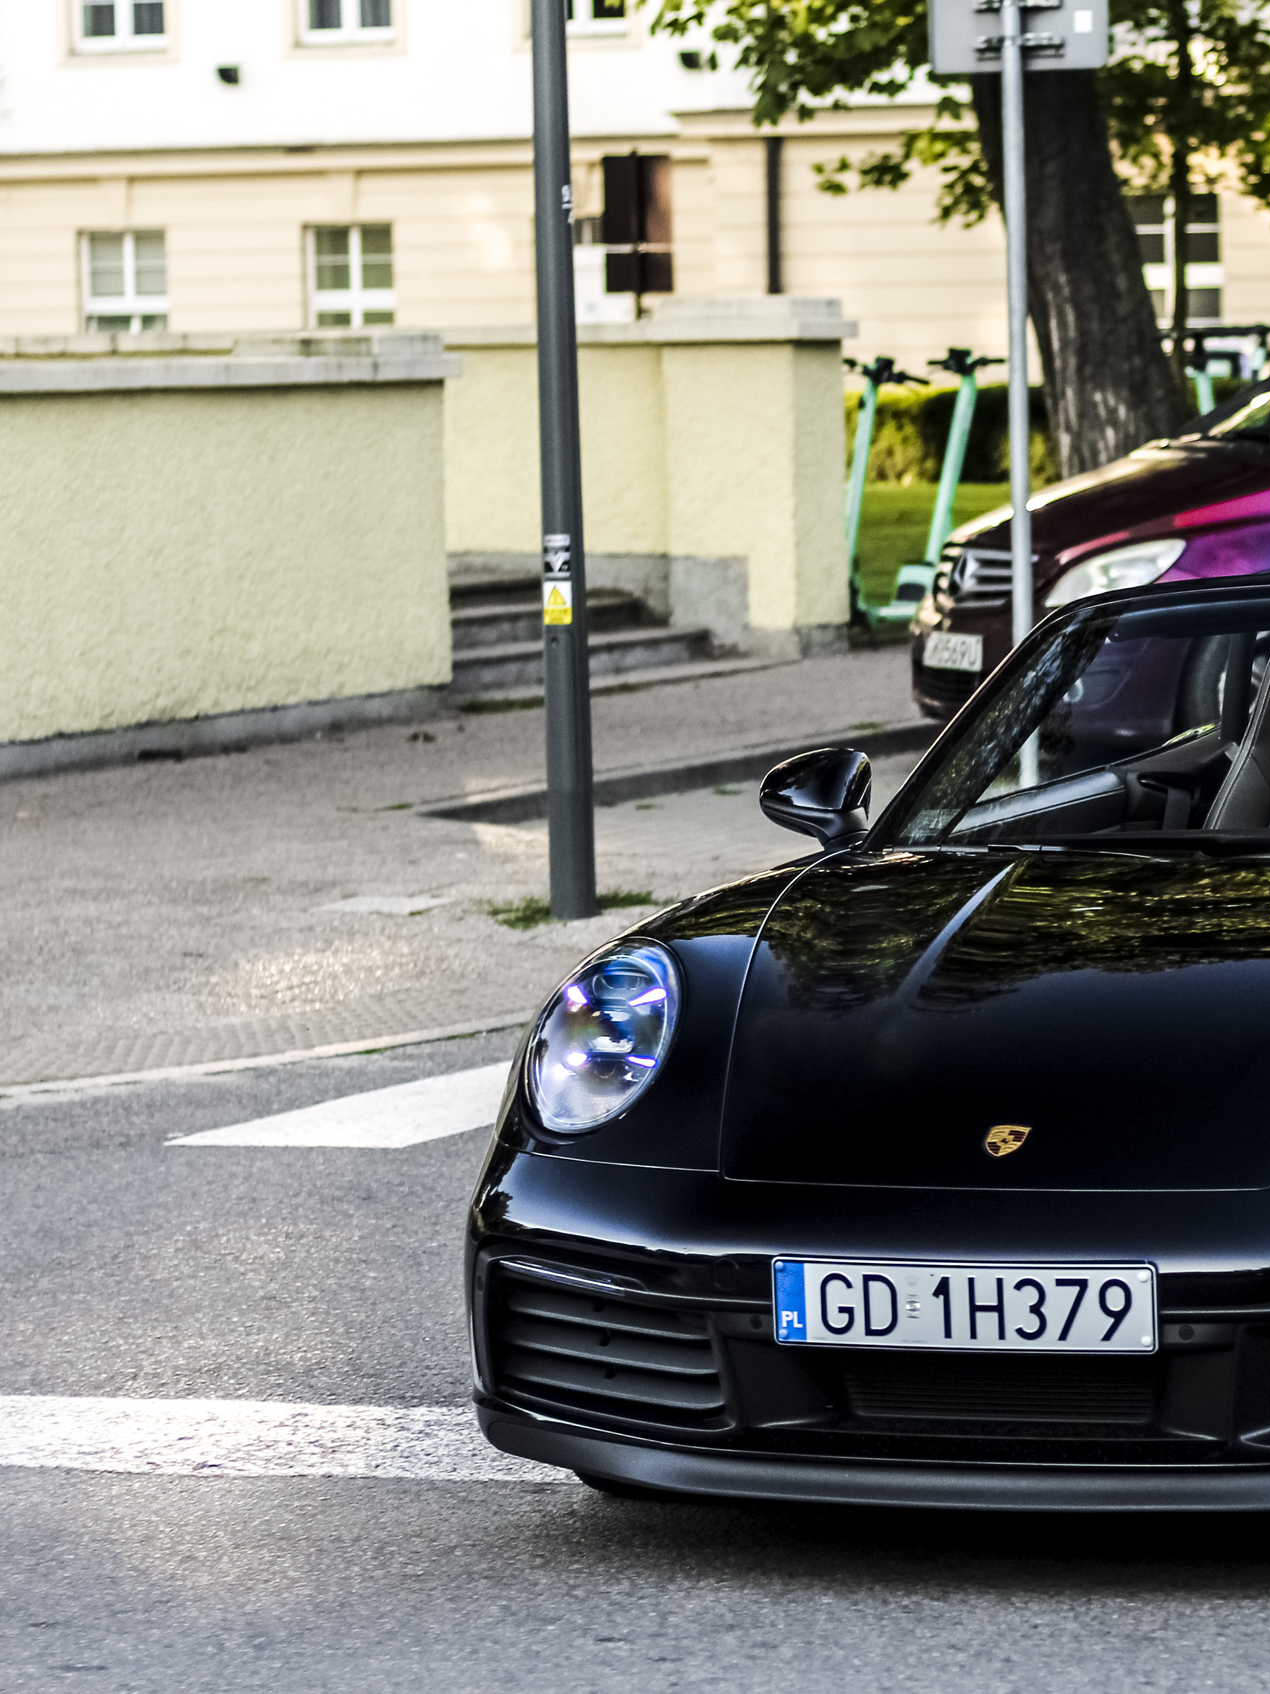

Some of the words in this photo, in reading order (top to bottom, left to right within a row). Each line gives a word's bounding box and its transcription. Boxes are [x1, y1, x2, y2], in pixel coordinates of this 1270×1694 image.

[781, 1310, 804, 1328] PL
[820, 1272, 899, 1337] GD
[932, 1275, 1133, 1342] 1H379
